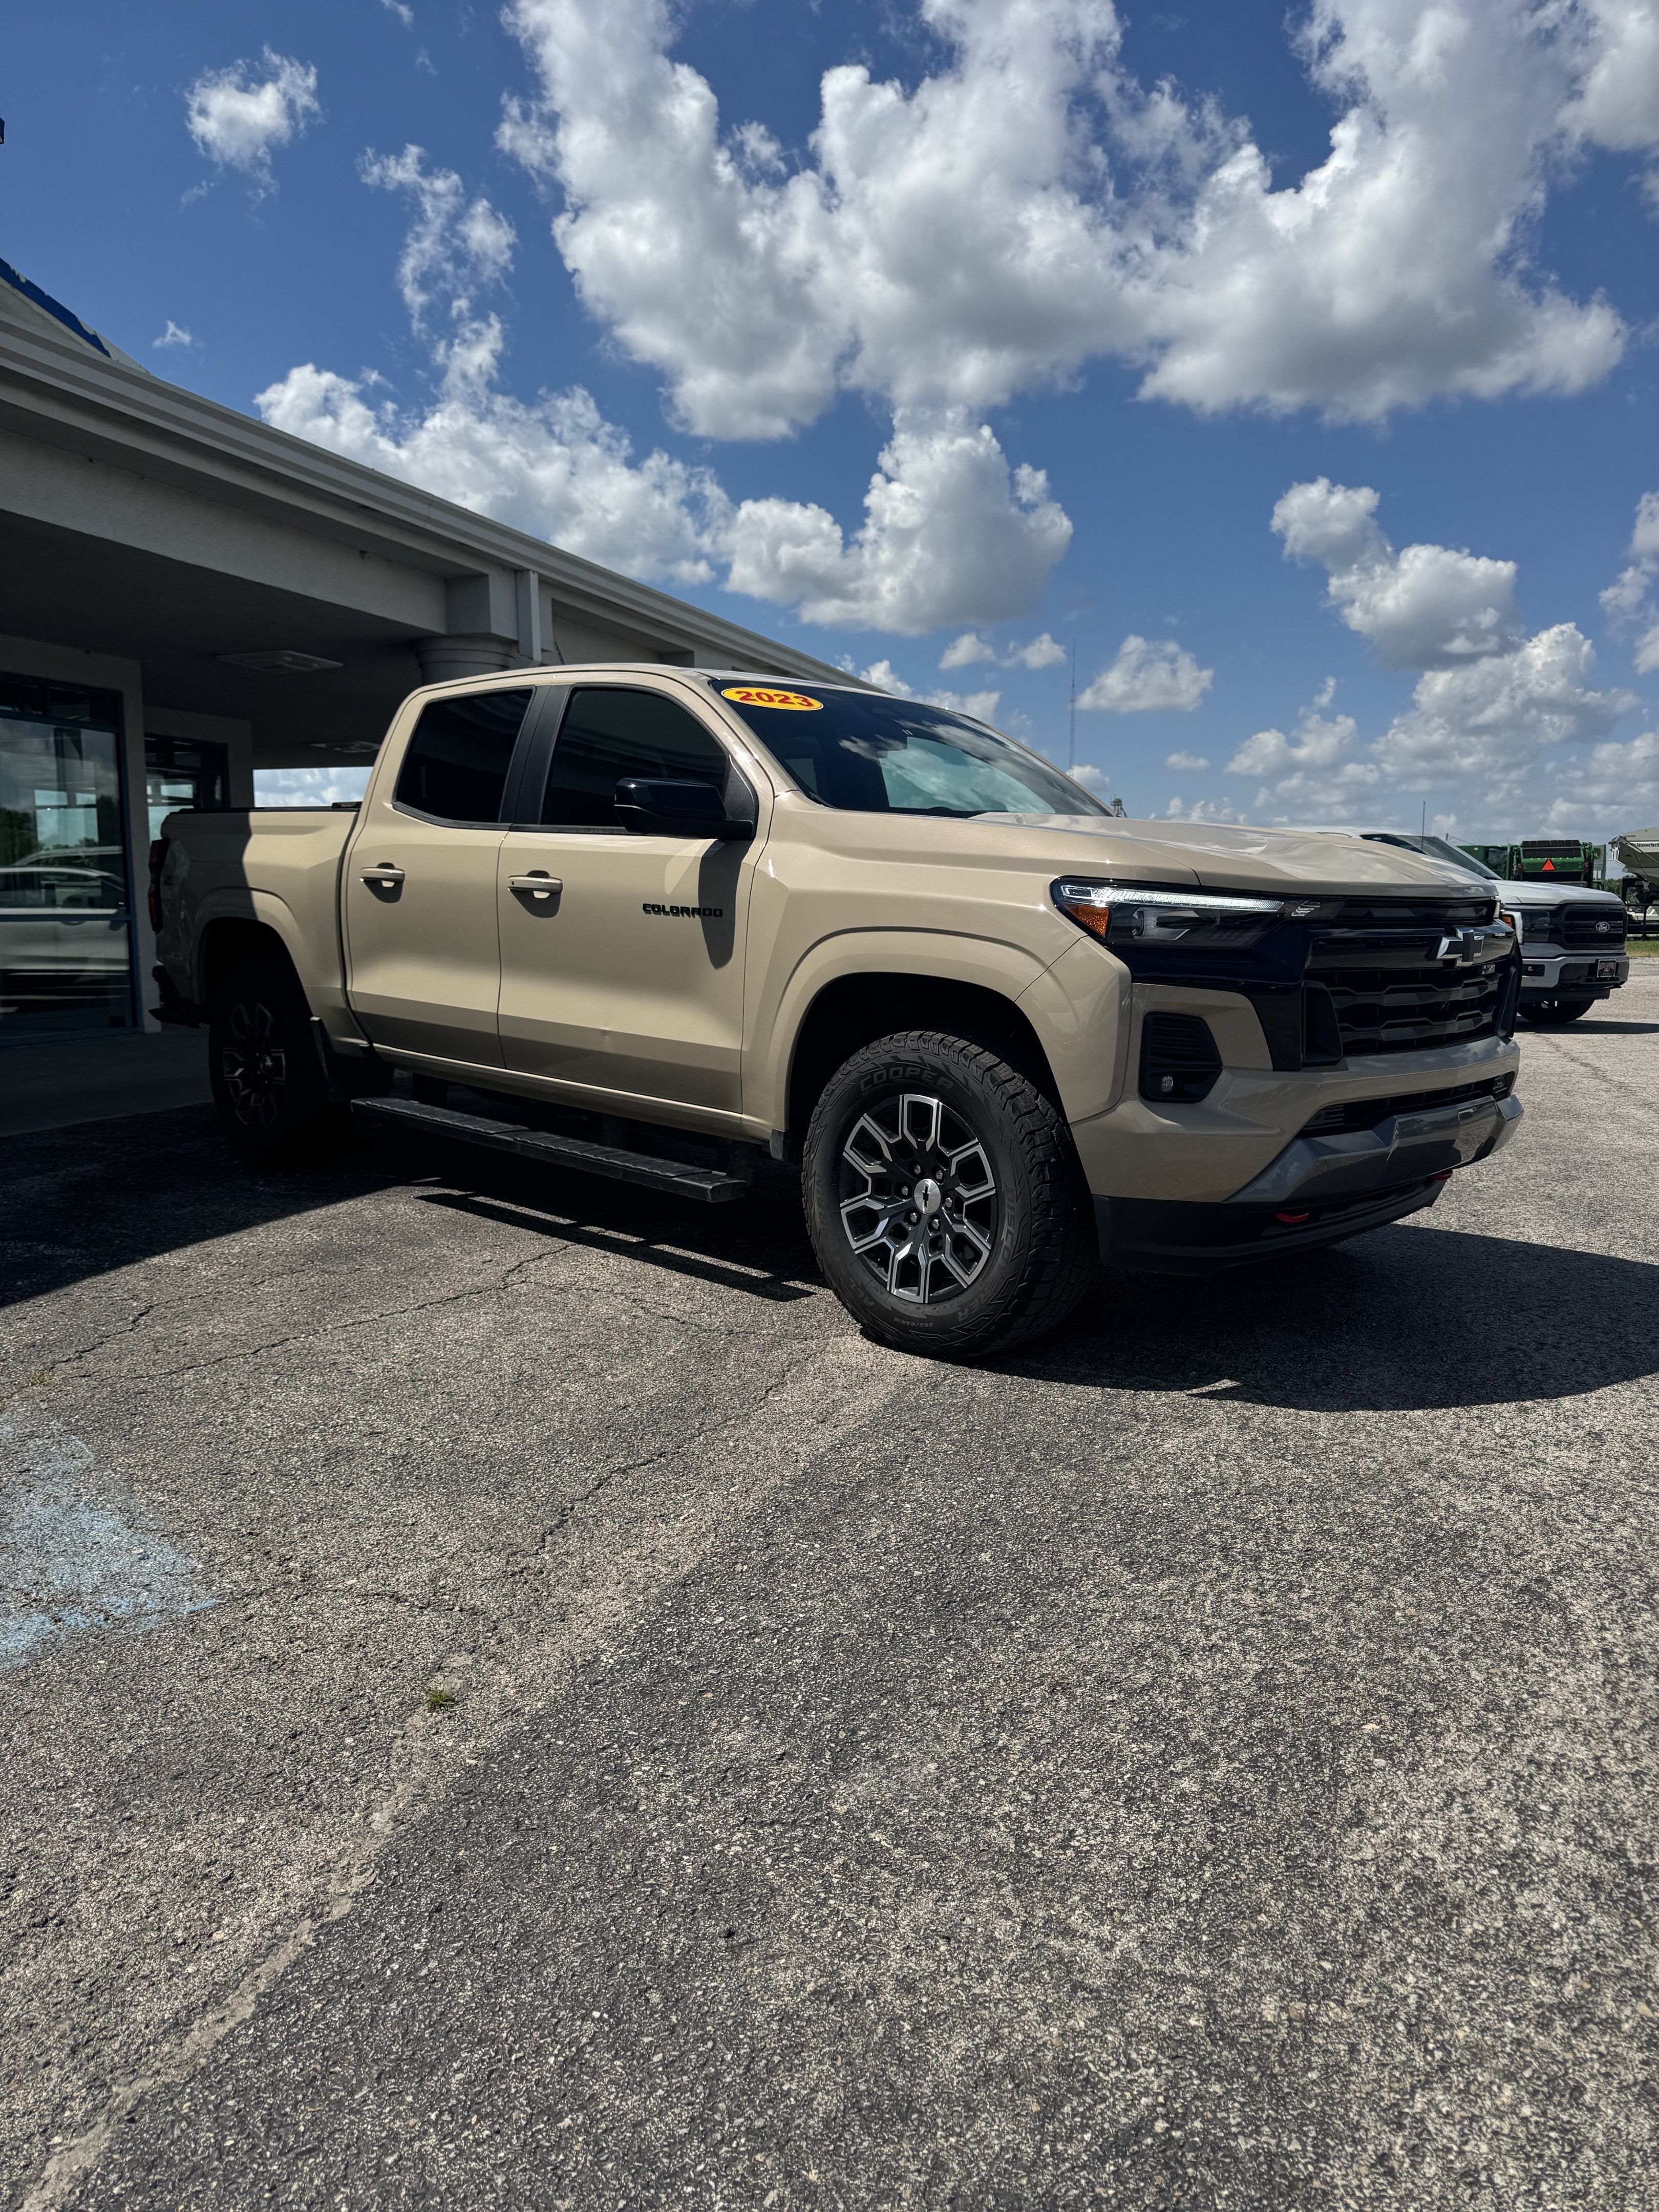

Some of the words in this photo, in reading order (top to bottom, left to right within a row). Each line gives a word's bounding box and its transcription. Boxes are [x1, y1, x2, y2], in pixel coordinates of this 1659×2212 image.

[735, 691, 815, 707] 2023
[643, 903, 723, 917] COLORADO
[860, 1067, 954, 1092] COOPER
